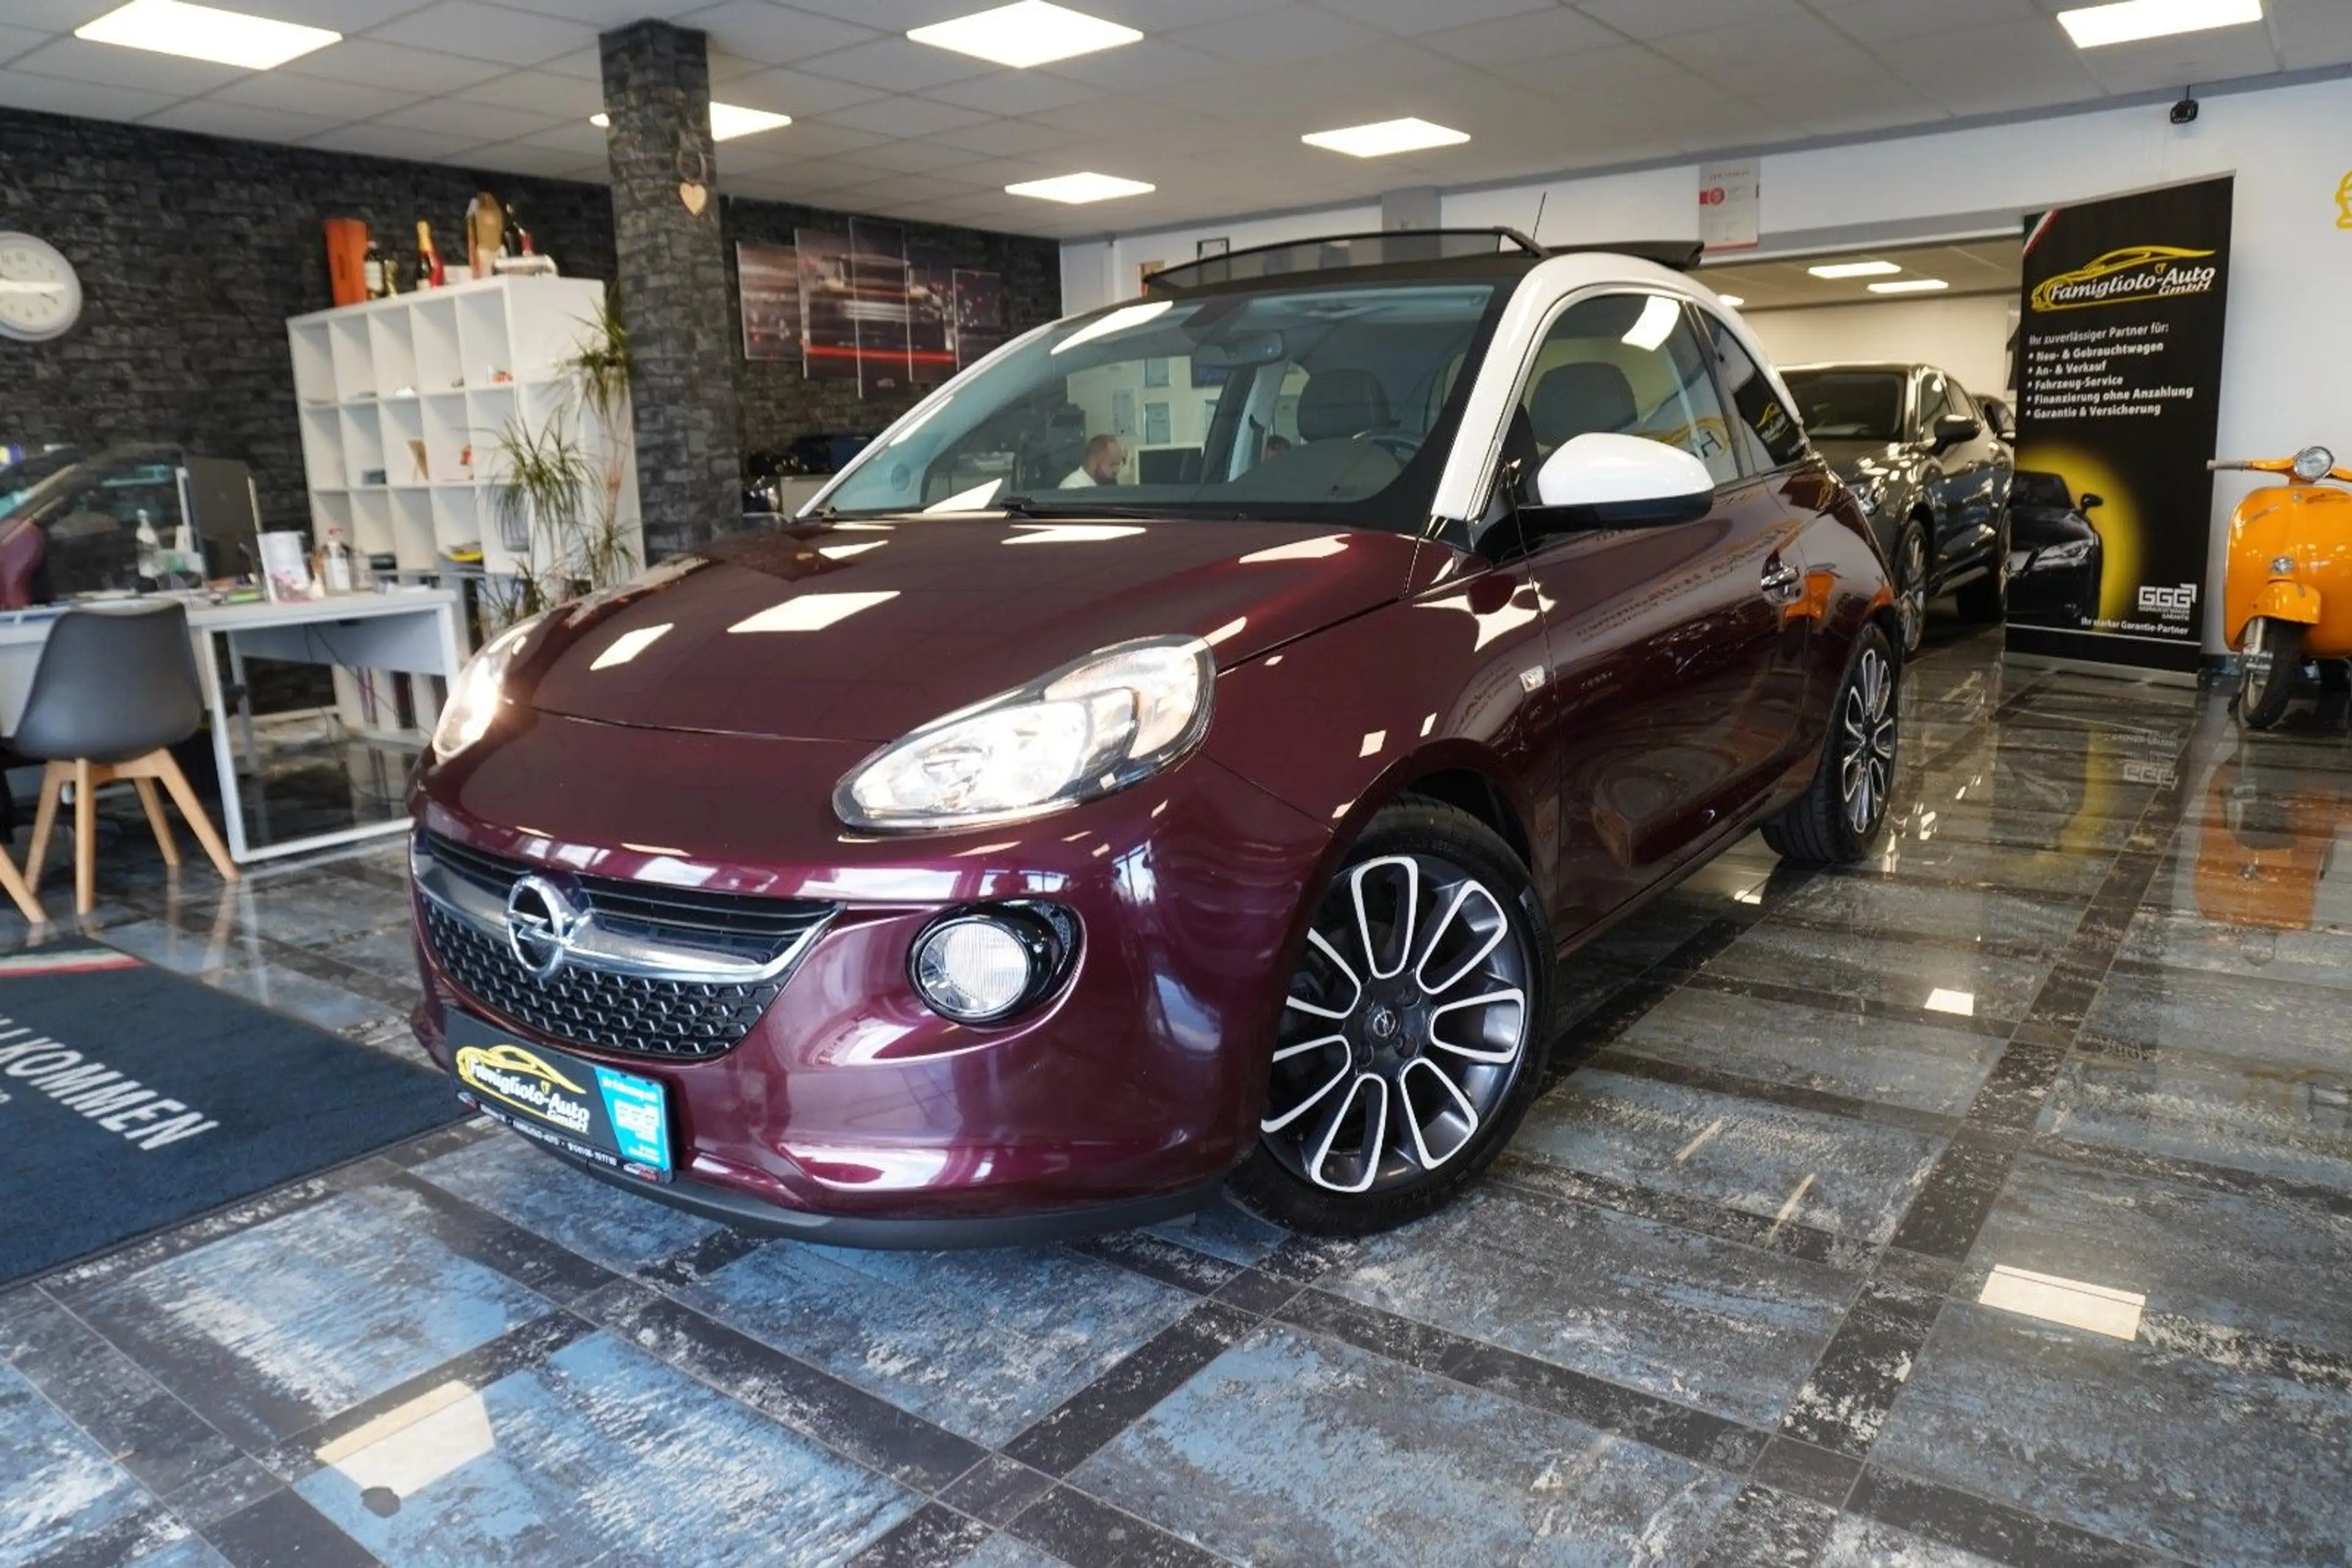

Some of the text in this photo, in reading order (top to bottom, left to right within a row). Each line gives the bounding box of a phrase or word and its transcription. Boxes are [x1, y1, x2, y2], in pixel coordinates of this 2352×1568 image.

[2158, 279, 2211, 295] GmbH
[2029, 335, 2042, 345] Ihr
[2043, 329, 2106, 345] zuverlässiger
[2109, 325, 2149, 337] Partner
[2036, 342, 2164, 361] Neu- & Gebrauchtwagen
[2035, 360, 2108, 376] An- & Verkauf
[2034, 375, 2124, 391] Fahrzeug-Service
[2034, 385, 2193, 405] Finanzierung ohne Anzahlung
[2033, 403, 2162, 419] Garantie & Versicherung
[2138, 586, 2192, 608] GGG
